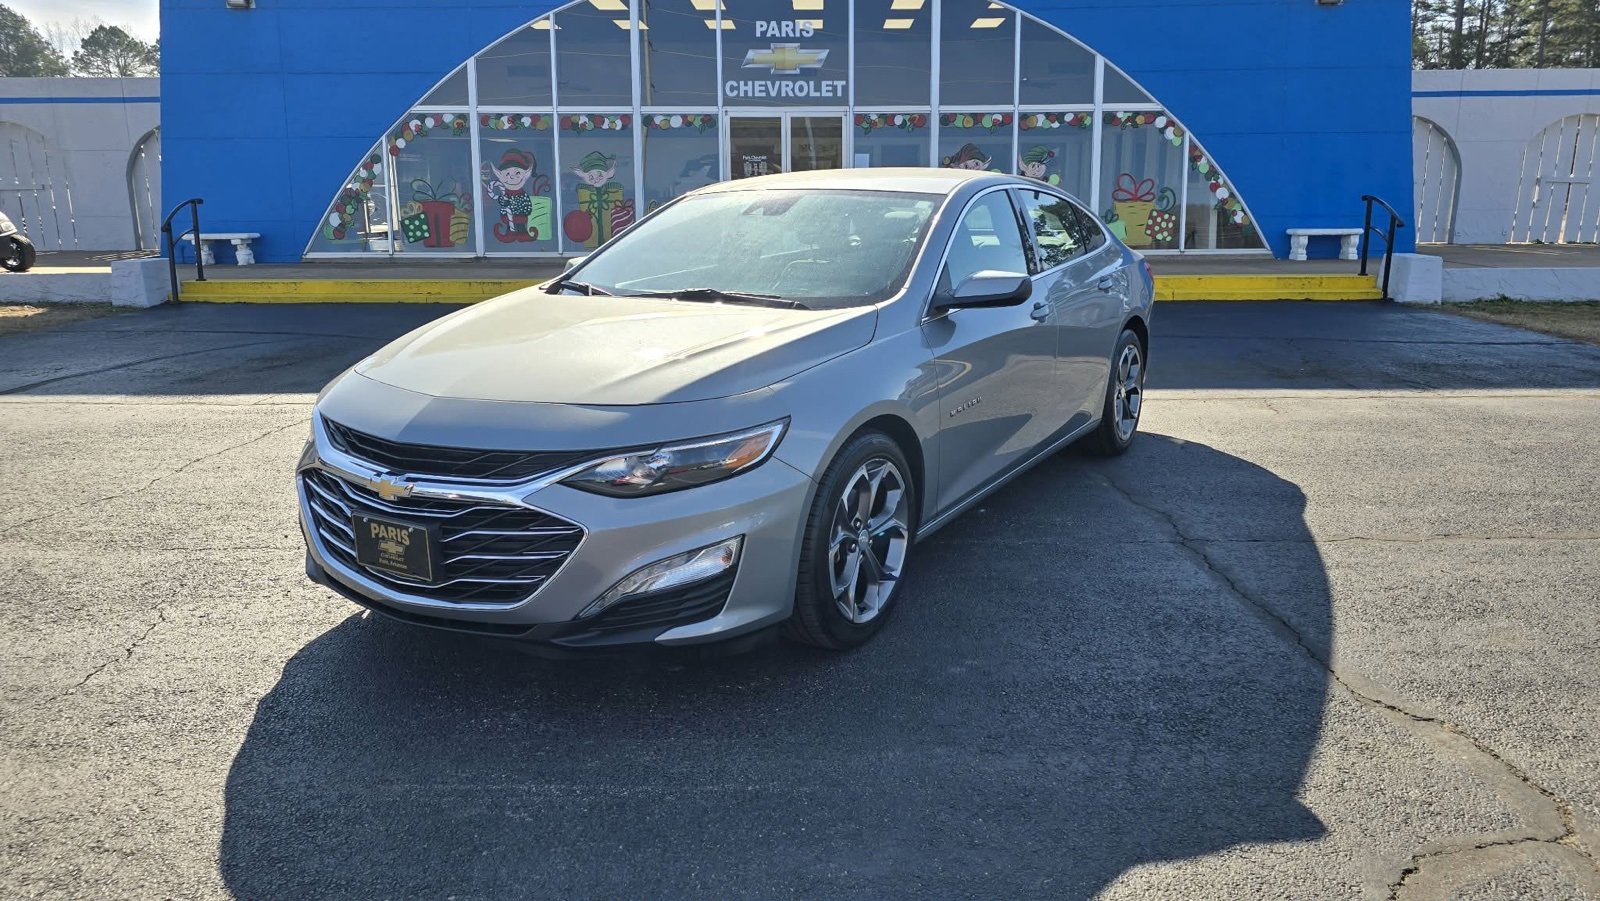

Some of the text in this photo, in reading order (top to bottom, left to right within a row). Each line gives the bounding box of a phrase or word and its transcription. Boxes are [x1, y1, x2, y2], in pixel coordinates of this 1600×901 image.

[755, 20, 814, 38] PARIS
[725, 80, 847, 97] CHEVROLET
[370, 522, 410, 546] PARIS
